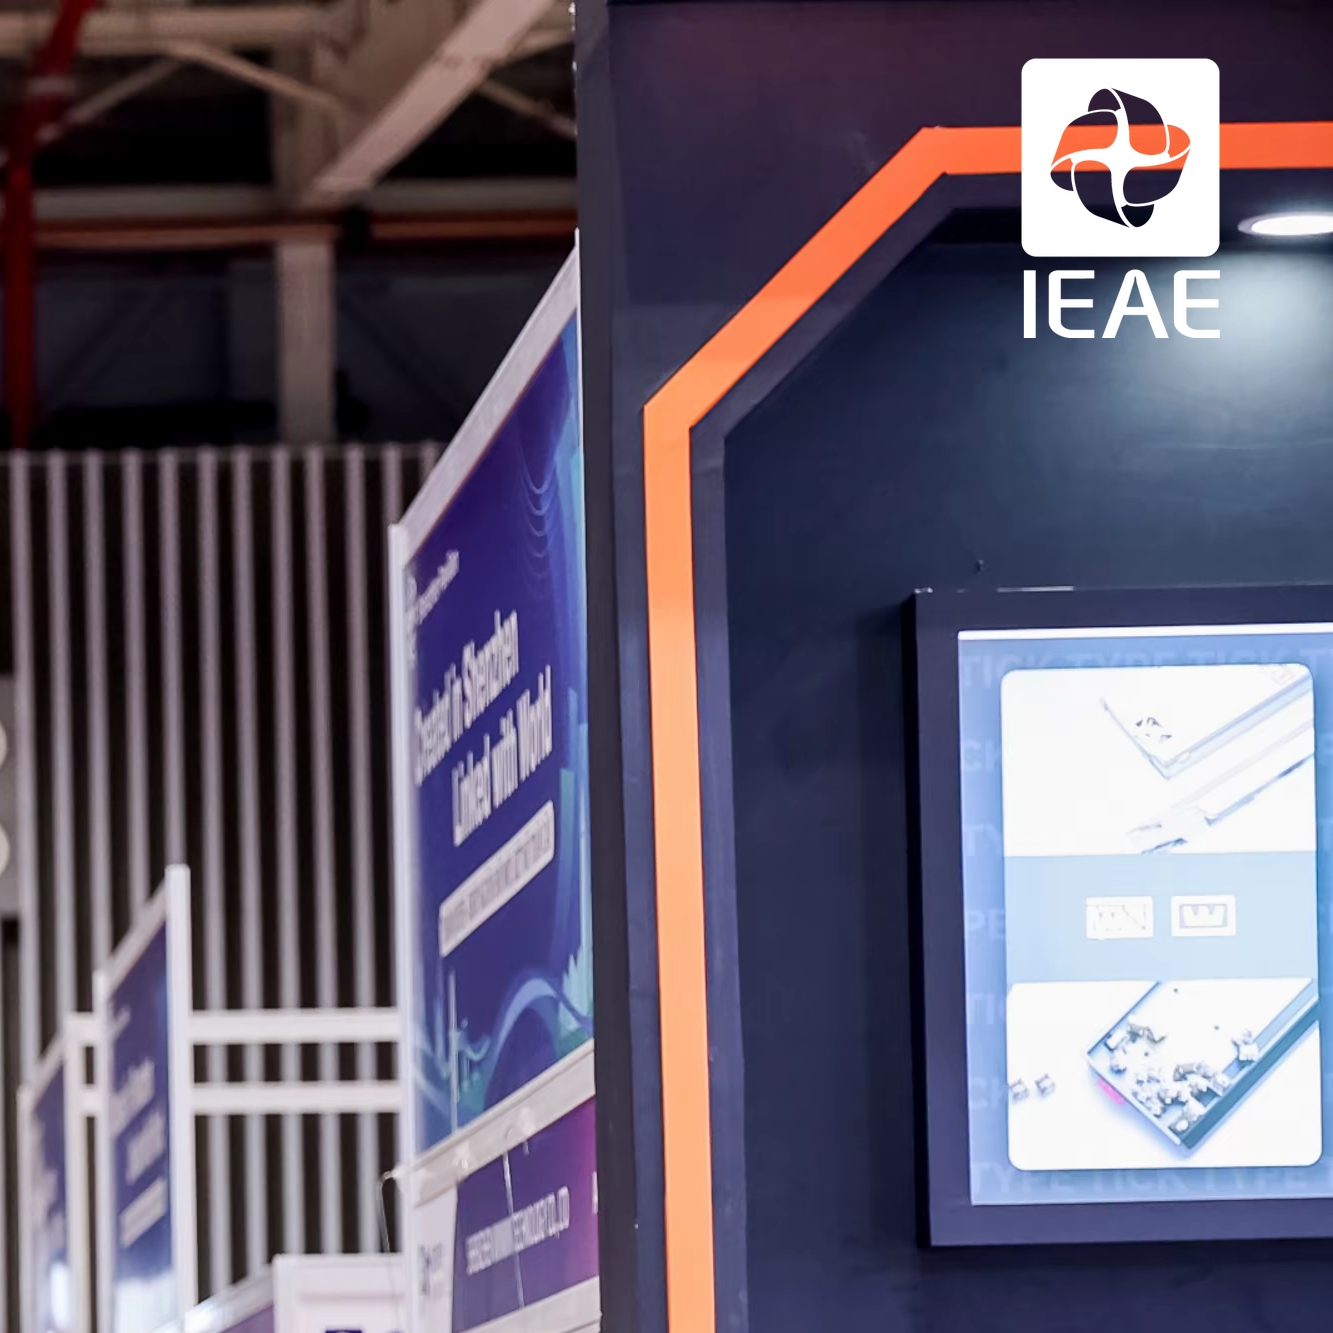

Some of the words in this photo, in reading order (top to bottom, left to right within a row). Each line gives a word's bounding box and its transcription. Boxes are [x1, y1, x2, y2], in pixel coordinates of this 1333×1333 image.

[463, 609, 519, 729] Shenzhen
[452, 733, 491, 847] Linked
[517, 664, 553, 782] World
